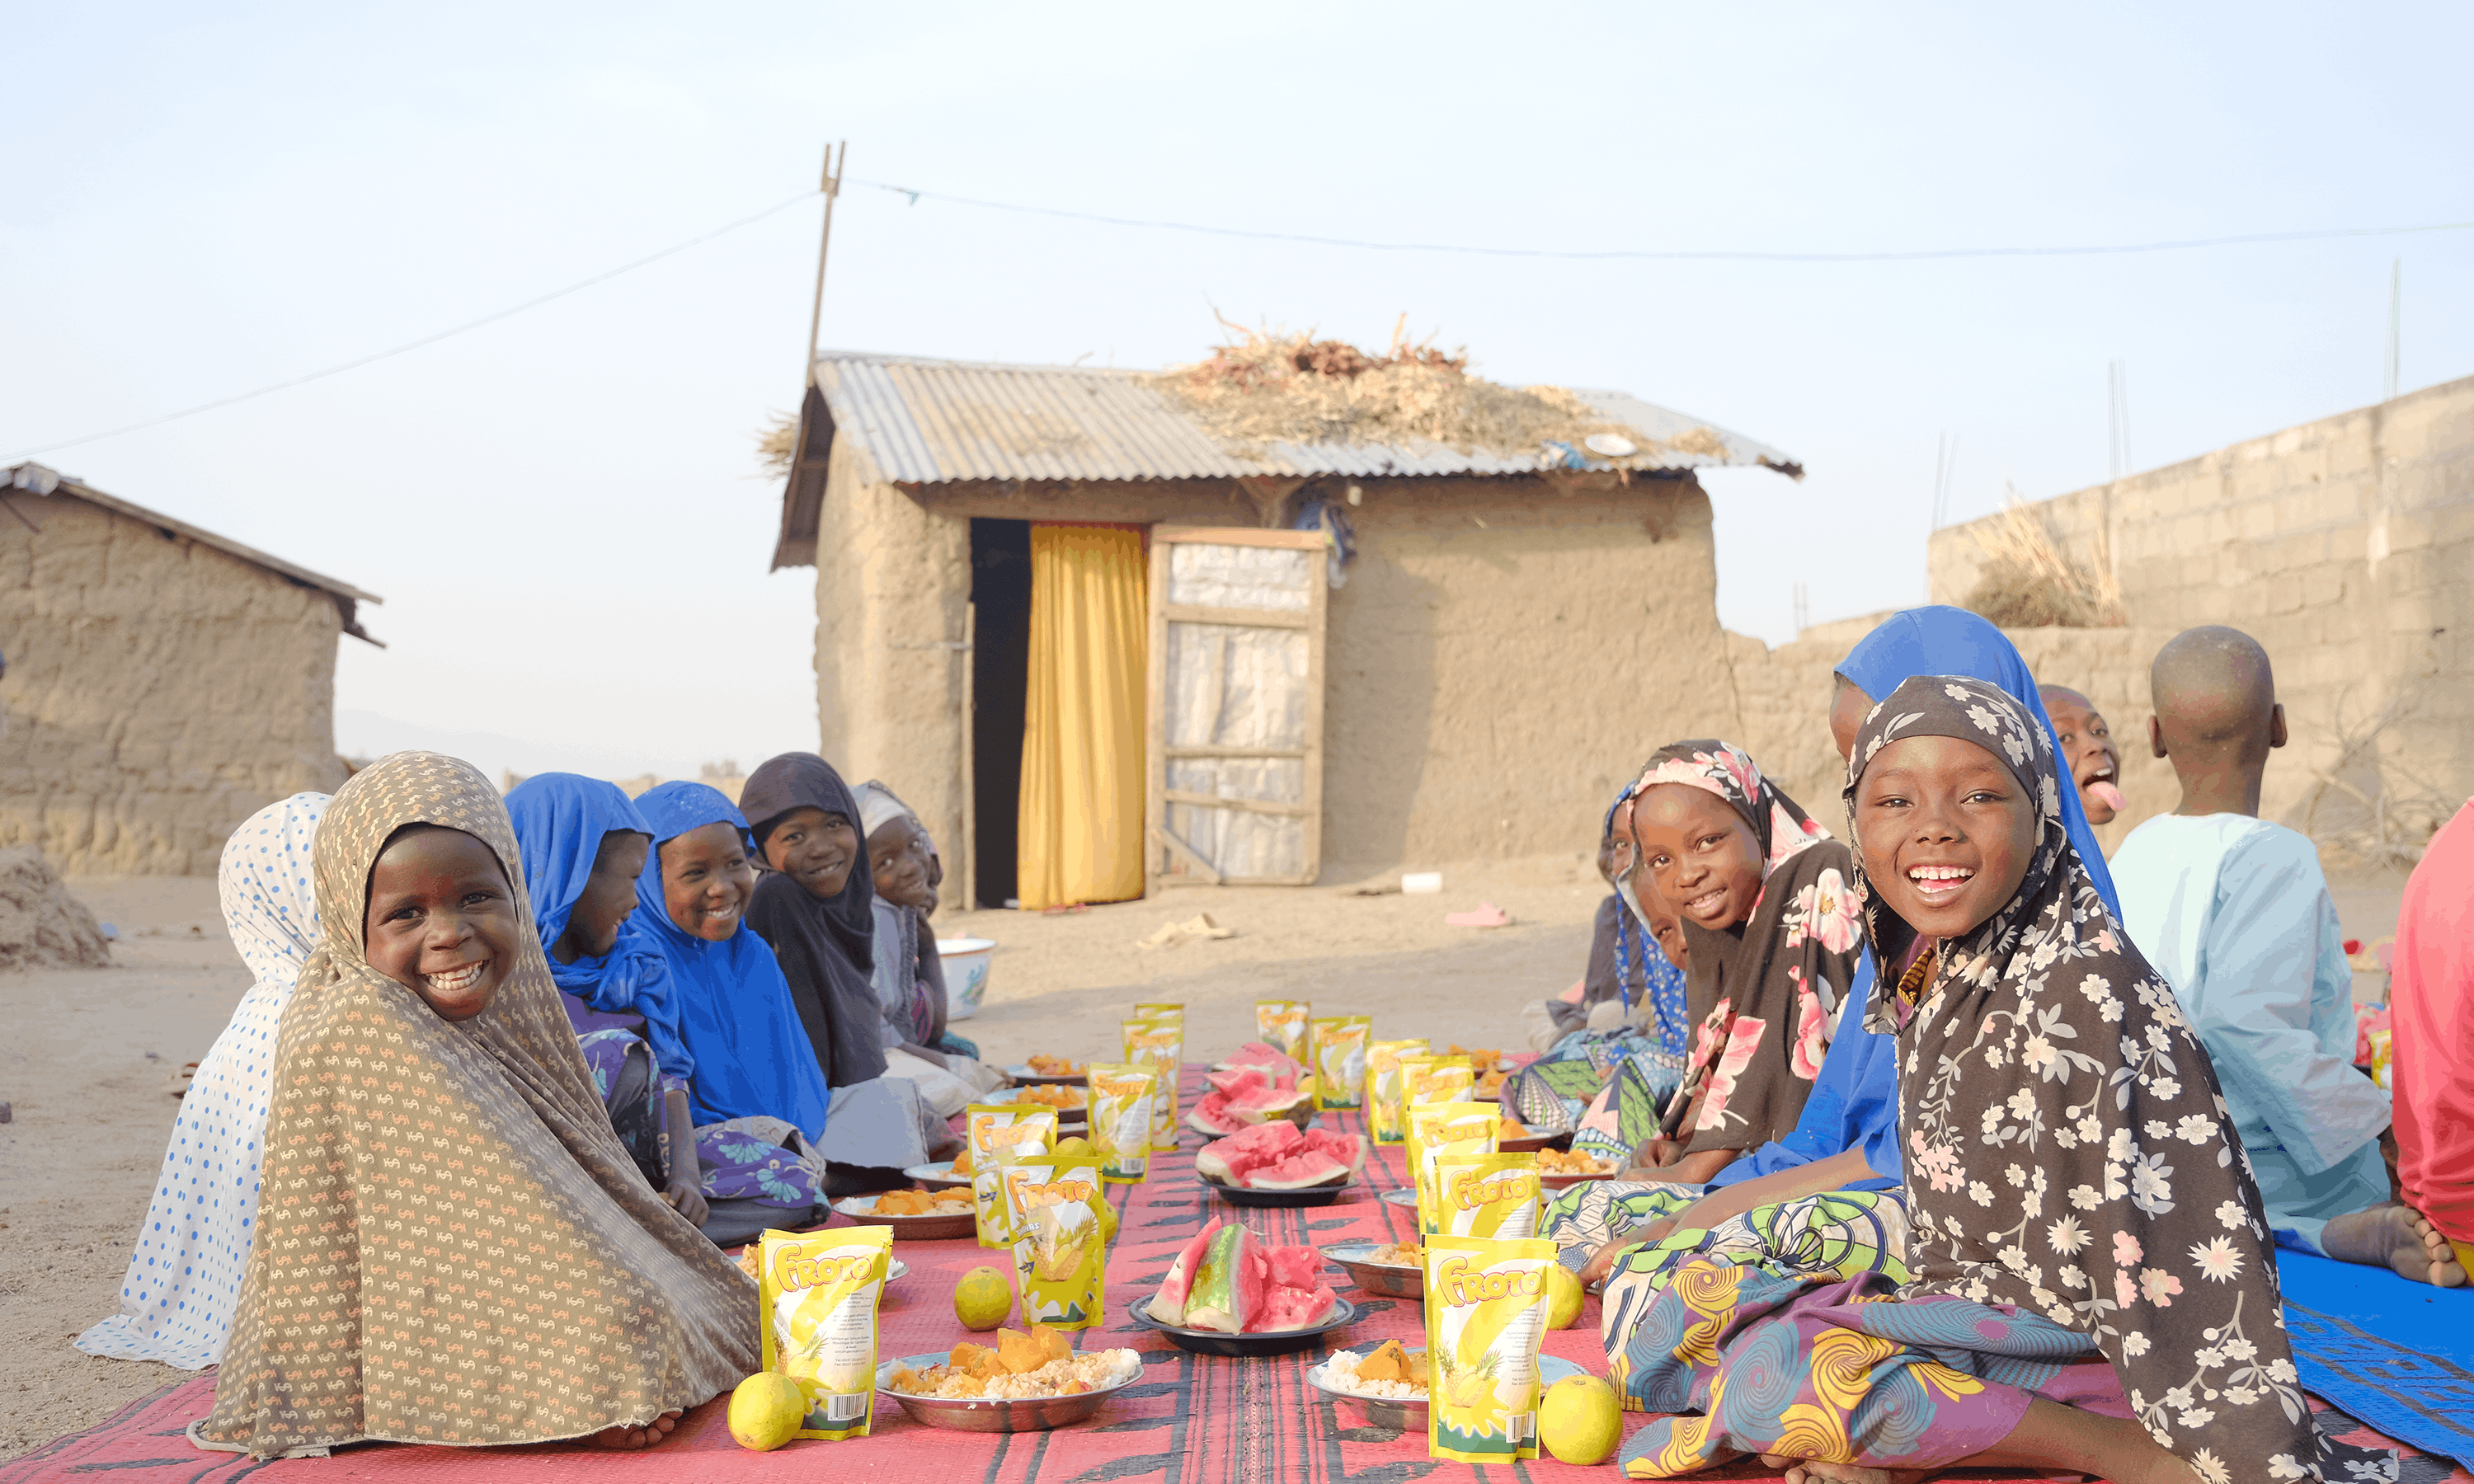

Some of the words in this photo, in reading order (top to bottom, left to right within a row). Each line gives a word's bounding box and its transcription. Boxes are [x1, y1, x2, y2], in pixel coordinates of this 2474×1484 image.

[1008, 1170, 1094, 1215] FROTO
[1448, 1169, 1529, 1211] FROTO
[774, 1243, 872, 1293] FROTO
[1438, 1256, 1543, 1308] FROTO
